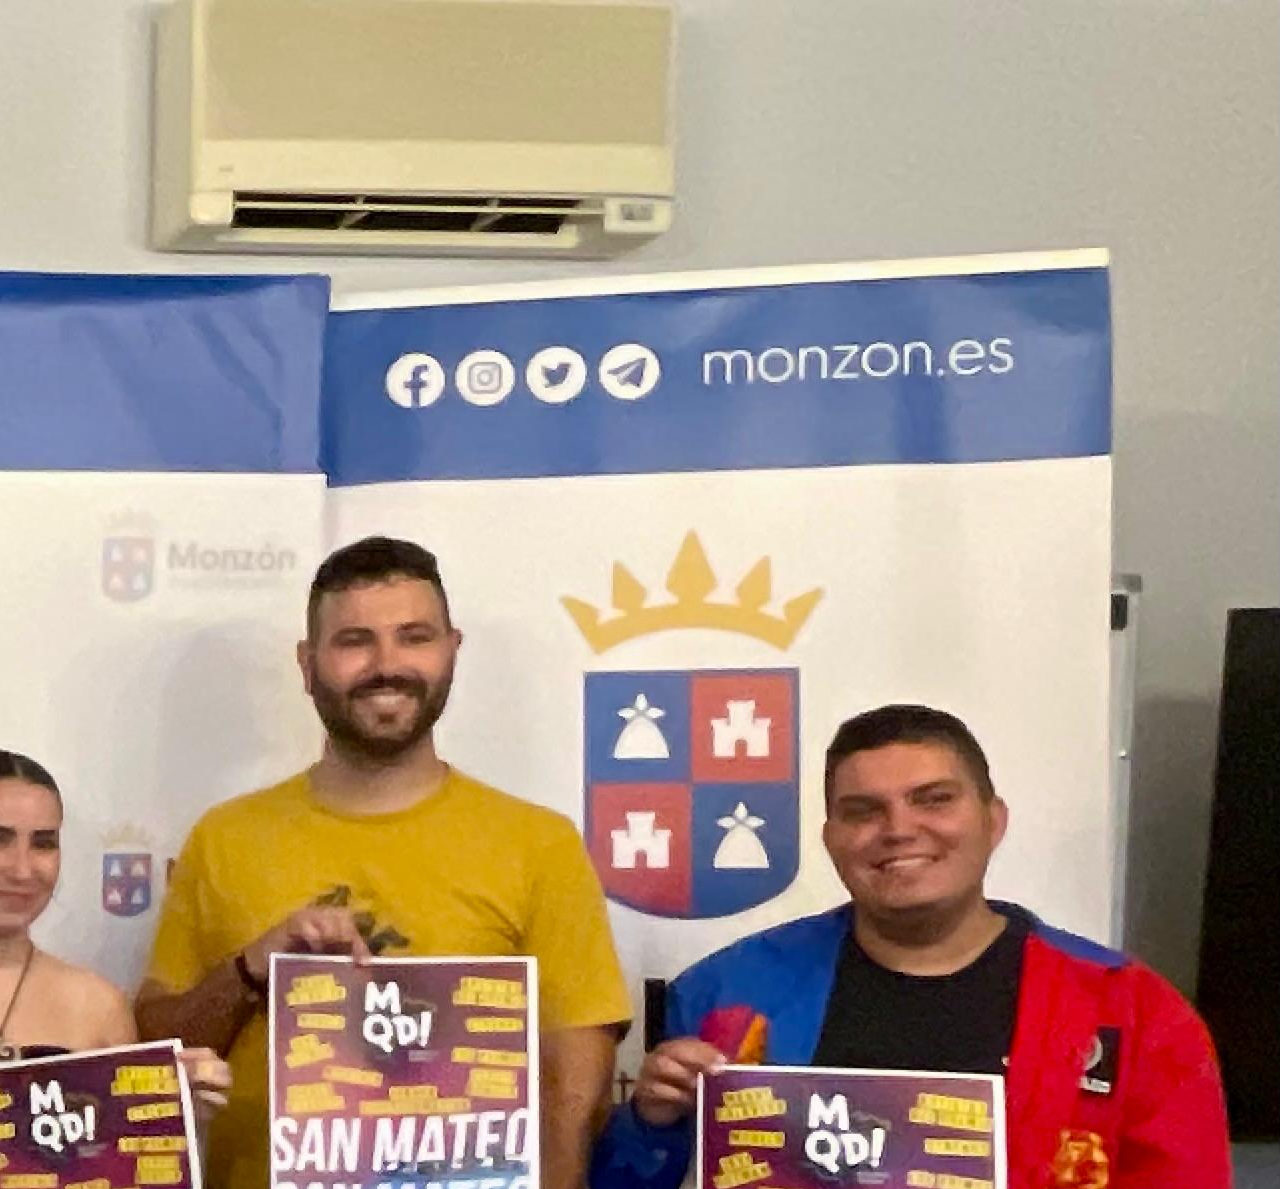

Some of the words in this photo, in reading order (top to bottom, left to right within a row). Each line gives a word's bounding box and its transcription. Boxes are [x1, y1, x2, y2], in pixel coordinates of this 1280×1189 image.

[702, 331, 1016, 387] monzon.es
[167, 541, 298, 571] Monzón
[365, 981, 401, 1014] M
[363, 1011, 432, 1053] QD!
[30, 1080, 65, 1115] M
[808, 1094, 850, 1130] M
[31, 1106, 96, 1152] QD!
[273, 1117, 361, 1172] SAN
[373, 1108, 528, 1173] MATEO
[804, 1127, 885, 1173] QD!
